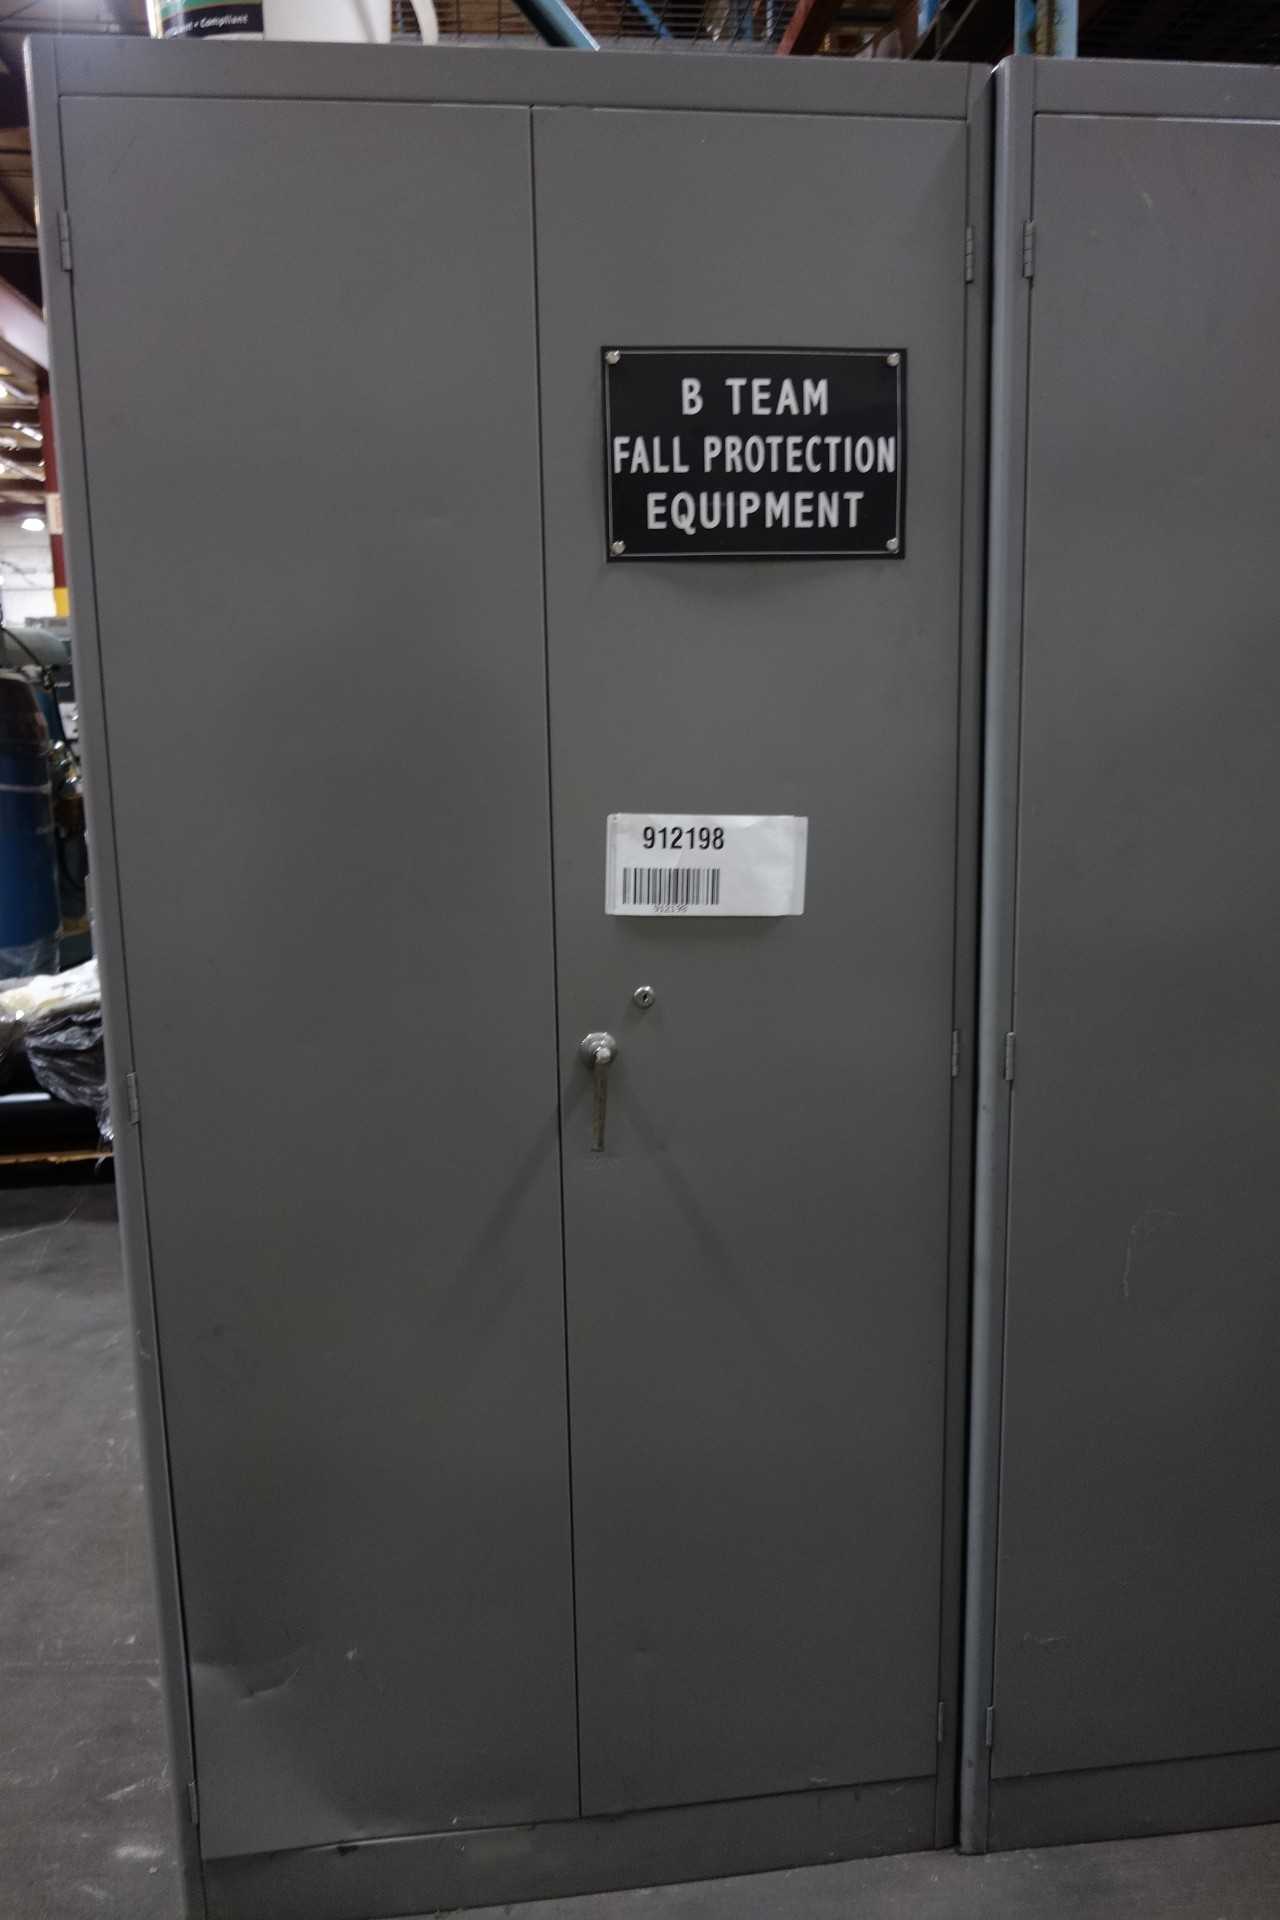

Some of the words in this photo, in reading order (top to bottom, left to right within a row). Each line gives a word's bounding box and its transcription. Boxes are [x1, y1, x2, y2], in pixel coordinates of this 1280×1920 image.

[681, 377, 704, 416] B
[725, 377, 829, 416] TEAM
[613, 435, 690, 474] FALL
[703, 435, 896, 473] PROTECTION
[646, 491, 864, 536] EQUIPMENT
[643, 826, 725, 850] 912198
